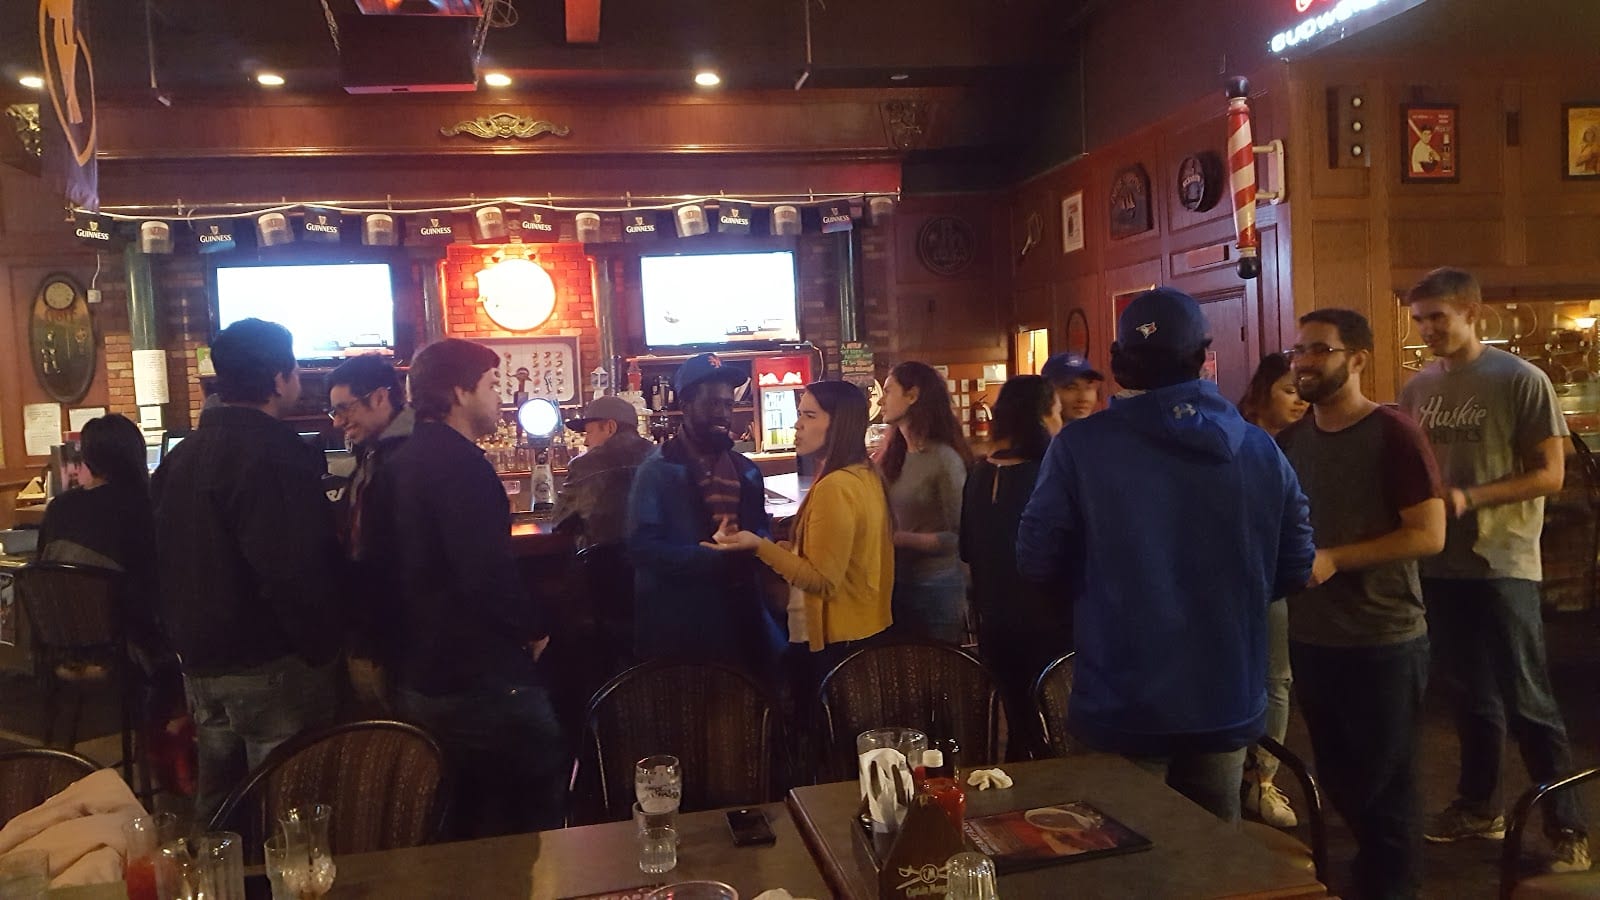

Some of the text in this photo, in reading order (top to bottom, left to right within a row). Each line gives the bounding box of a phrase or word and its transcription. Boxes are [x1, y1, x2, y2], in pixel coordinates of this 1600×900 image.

[720, 215, 749, 226] GUINNESS
[822, 214, 850, 224] GUINNESS
[305, 223, 338, 234] GUINNESS
[420, 227, 452, 236] GUINNESS
[521, 221, 552, 232] GUINNESS
[626, 224, 655, 234] GUINNESS
[75, 228, 110, 241] GUINNESS
[199, 234, 232, 243] GUINNESS
[1419, 395, 1487, 429] Huskie
